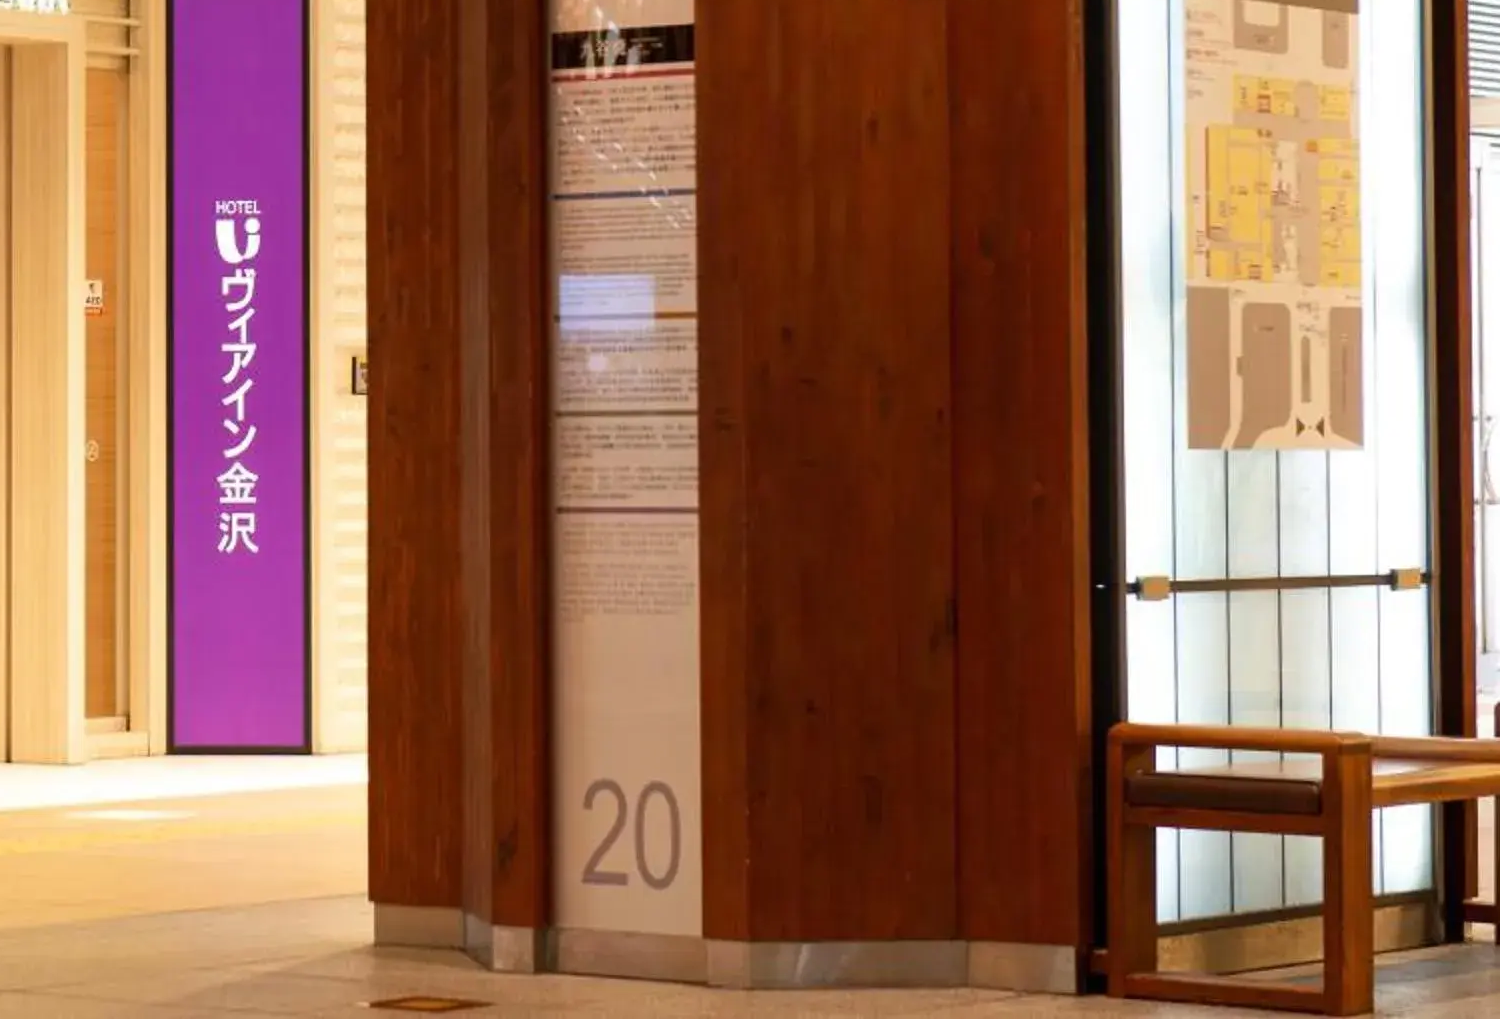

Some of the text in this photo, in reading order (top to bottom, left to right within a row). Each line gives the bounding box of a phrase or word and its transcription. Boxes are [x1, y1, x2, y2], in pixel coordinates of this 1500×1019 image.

[215, 200, 262, 214] HOTEL
[216, 267, 260, 554] ヴィアイン金沢
[580, 777, 682, 891] 20
